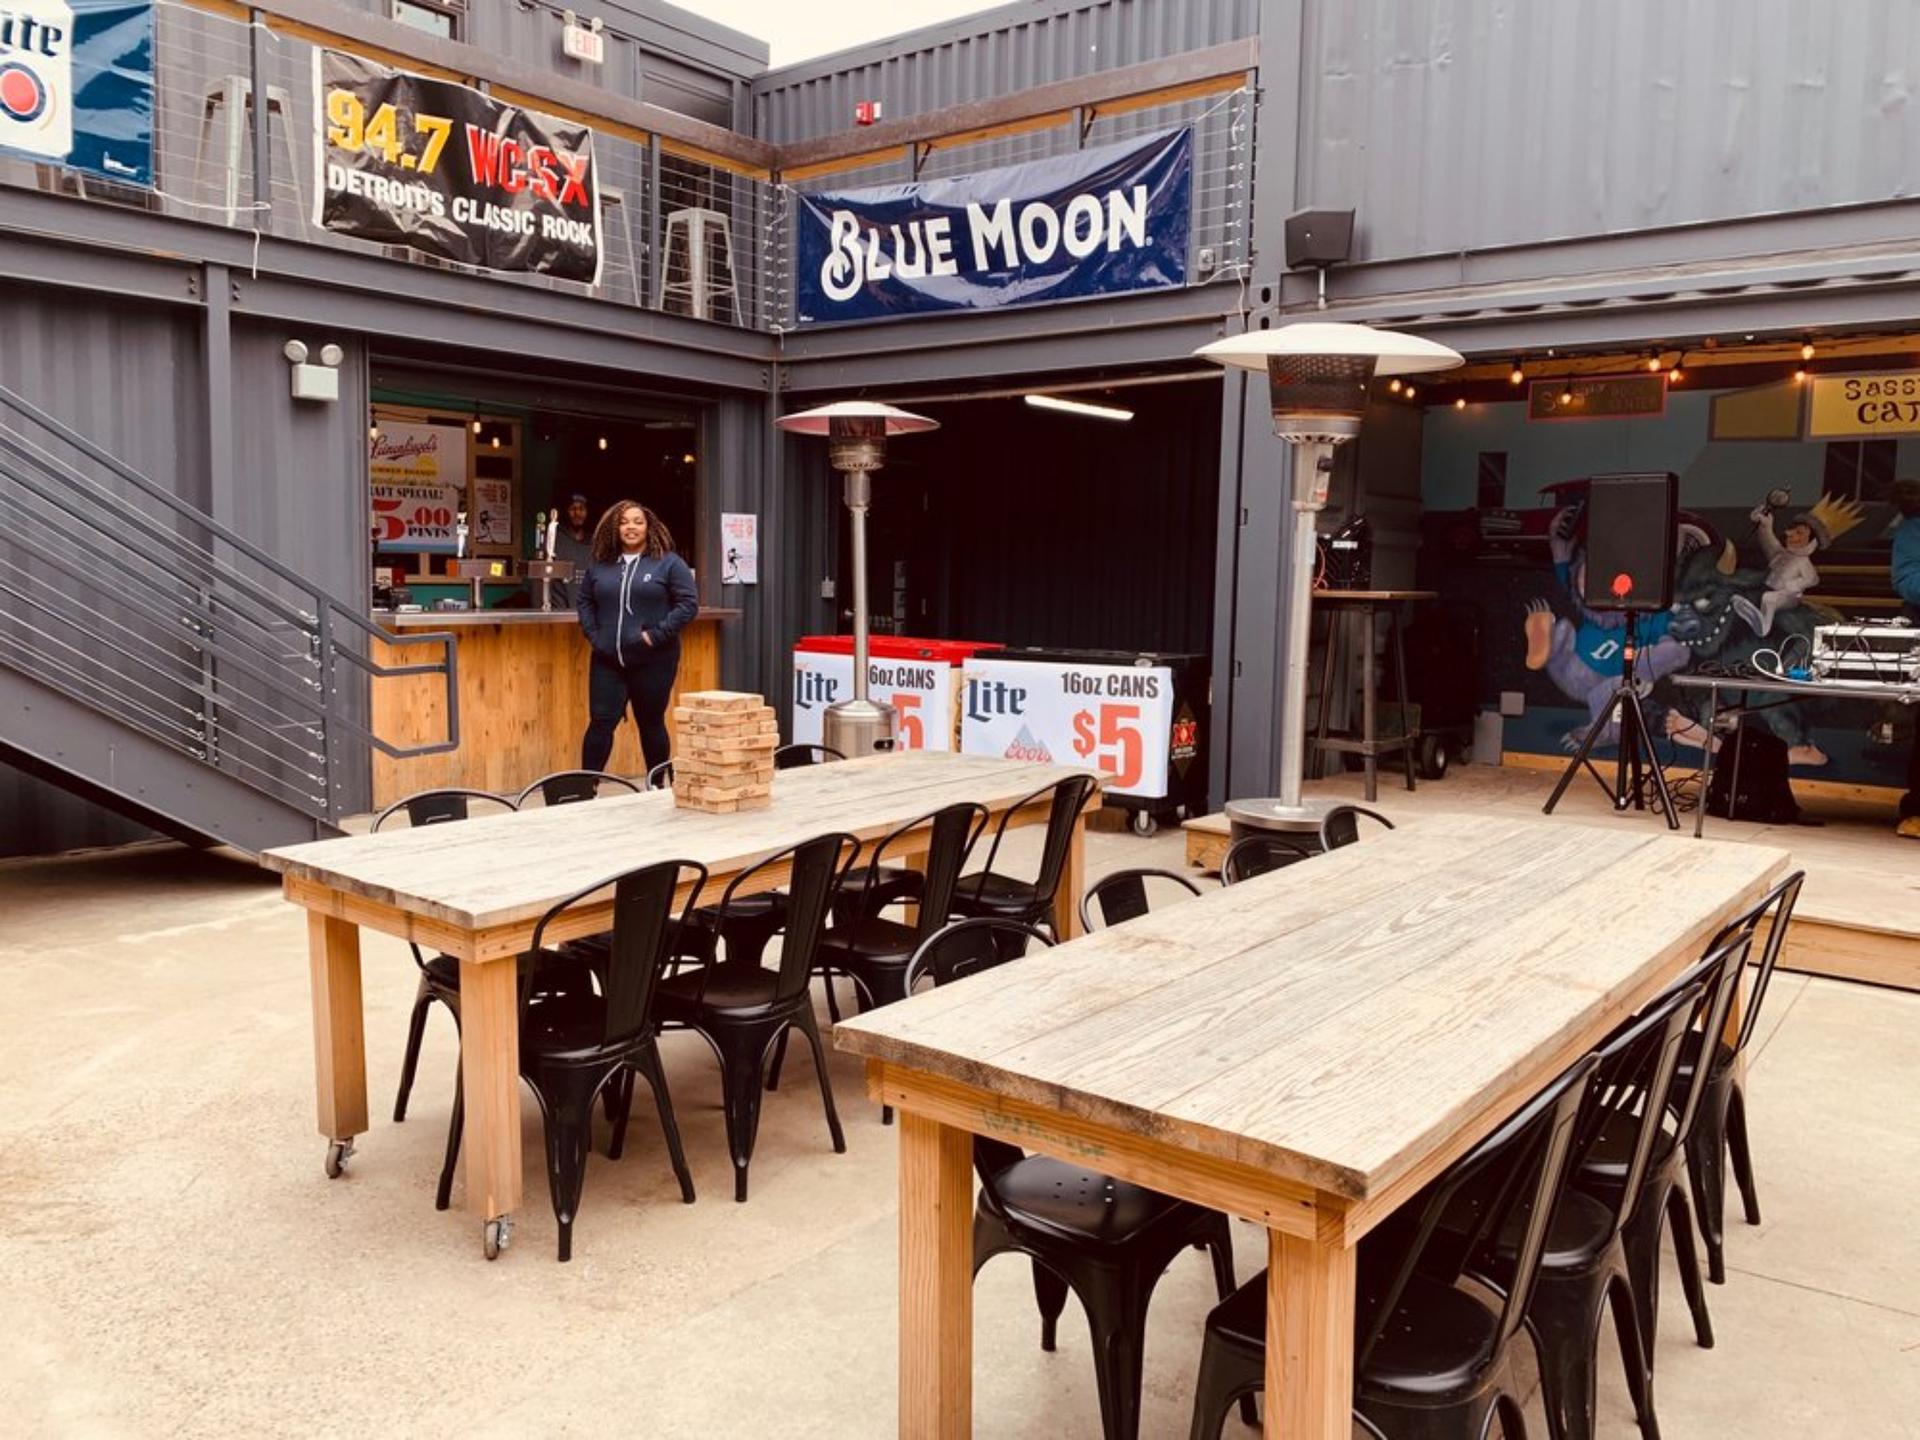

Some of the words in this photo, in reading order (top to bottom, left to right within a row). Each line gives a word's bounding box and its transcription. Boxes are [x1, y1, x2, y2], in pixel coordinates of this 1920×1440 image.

[0, 11, 62, 57] ite
[327, 88, 453, 174] 94.7
[466, 123, 589, 207] WCSX
[328, 164, 445, 217] DETROIT'S
[452, 197, 535, 236] CLASSIC
[542, 211, 594, 247] ROCK
[821, 210, 958, 301] BLUE
[967, 185, 1148, 271] MOON
[1845, 379, 1920, 401] Sass
[370, 486, 394, 498] AFT
[408, 527, 450, 538] PINTS
[796, 669, 838, 709] Lite
[896, 667, 935, 690] CANS
[1061, 672, 1102, 696] 16oz
[1107, 674, 1159, 699] CANS
[892, 694, 924, 751] 5
[967, 679, 1027, 723] Lite
[1072, 703, 1144, 789] $5
